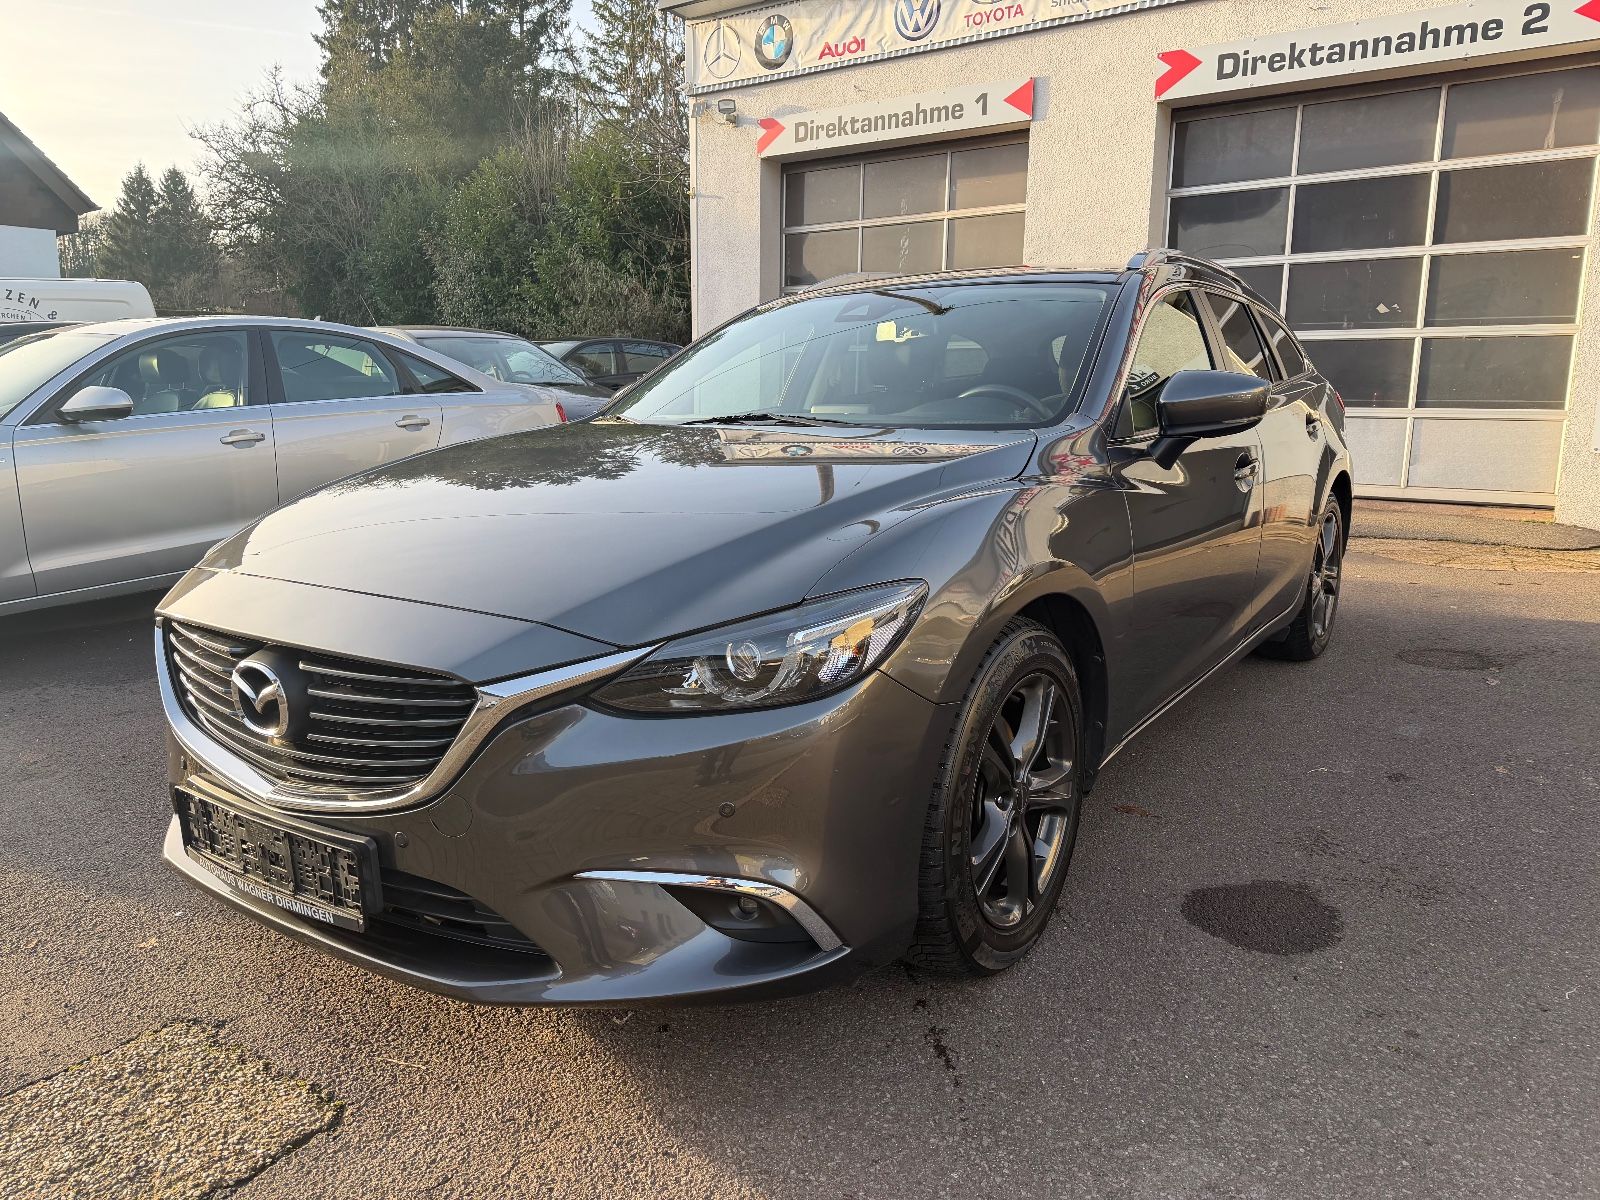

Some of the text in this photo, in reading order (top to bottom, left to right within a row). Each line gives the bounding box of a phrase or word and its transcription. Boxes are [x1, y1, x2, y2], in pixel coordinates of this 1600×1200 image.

[964, 4, 1025, 28] TOYOTA
[1216, 2, 1551, 80] Direktannahme 2
[794, 92, 989, 143] Direktannahme 1
[237, 879, 275, 904] WAGNER
[276, 896, 334, 924] DIRMINGEN
